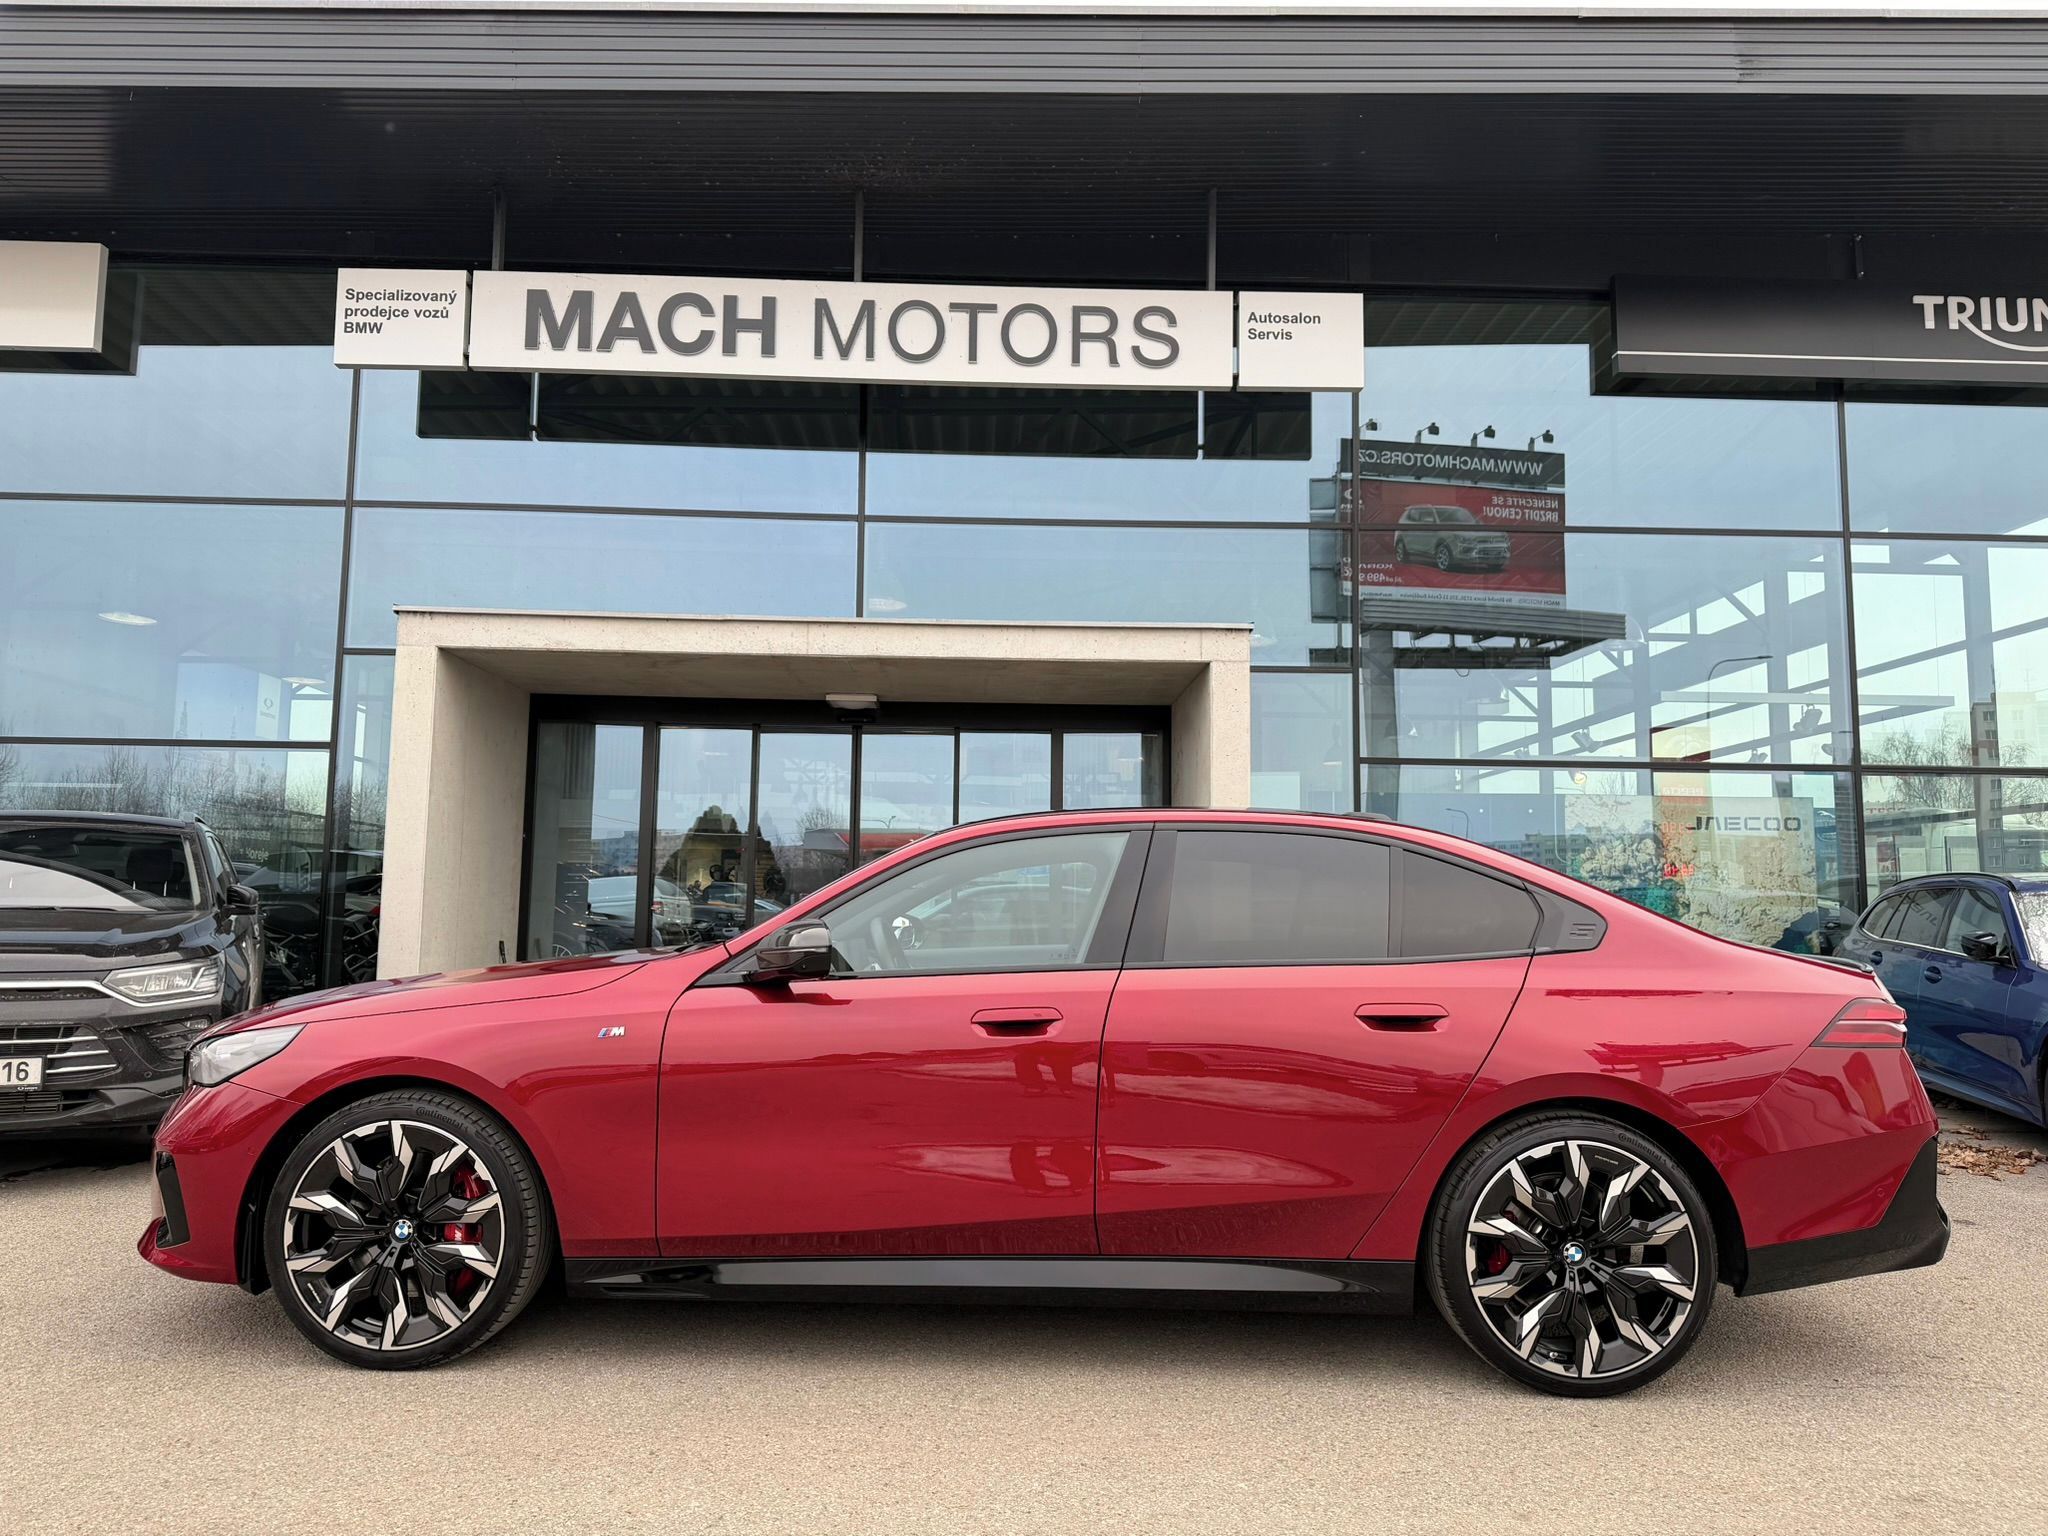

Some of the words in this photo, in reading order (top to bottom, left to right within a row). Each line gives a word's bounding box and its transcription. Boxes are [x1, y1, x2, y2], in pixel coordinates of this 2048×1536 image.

[345, 288, 457, 305] Specializovaný
[344, 306, 409, 320] prodejce
[414, 306, 449, 319] vozů
[1247, 311, 1321, 324] Autosalon
[344, 321, 383, 334] BMW
[524, 288, 777, 358] MACH
[813, 297, 1181, 369] MOTORS
[1248, 328, 1293, 340] Servis
[2, 1061, 30, 1082] 16
